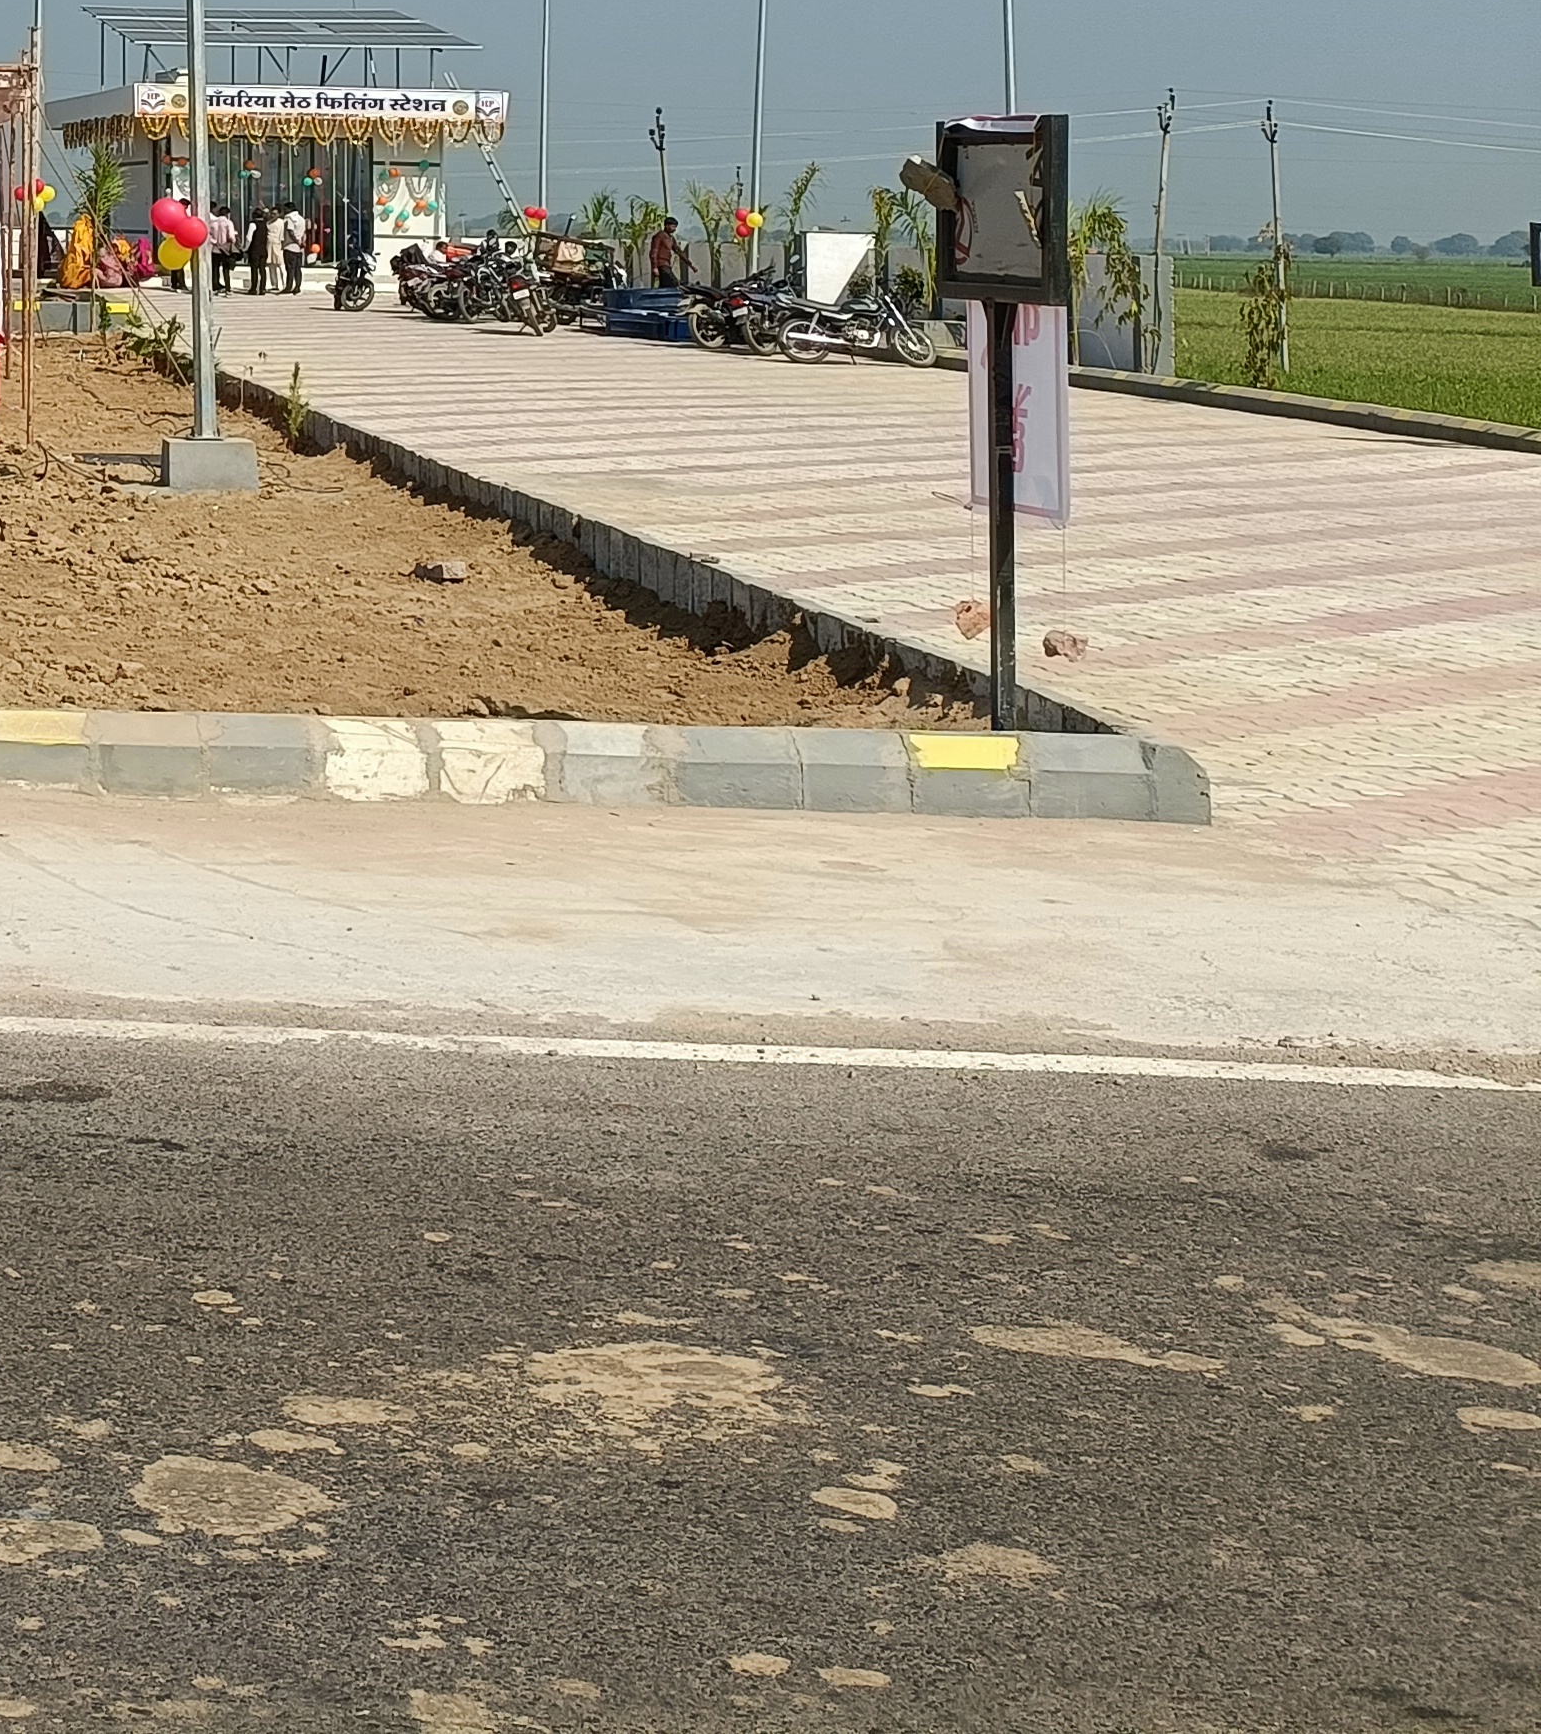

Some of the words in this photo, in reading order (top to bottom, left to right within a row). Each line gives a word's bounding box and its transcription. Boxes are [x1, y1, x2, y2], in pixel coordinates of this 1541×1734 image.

[146, 92, 160, 100] HP
[280, 90, 312, 109] सेठ
[316, 91, 384, 112] फिलिंग
[389, 93, 447, 112] स्टेशन
